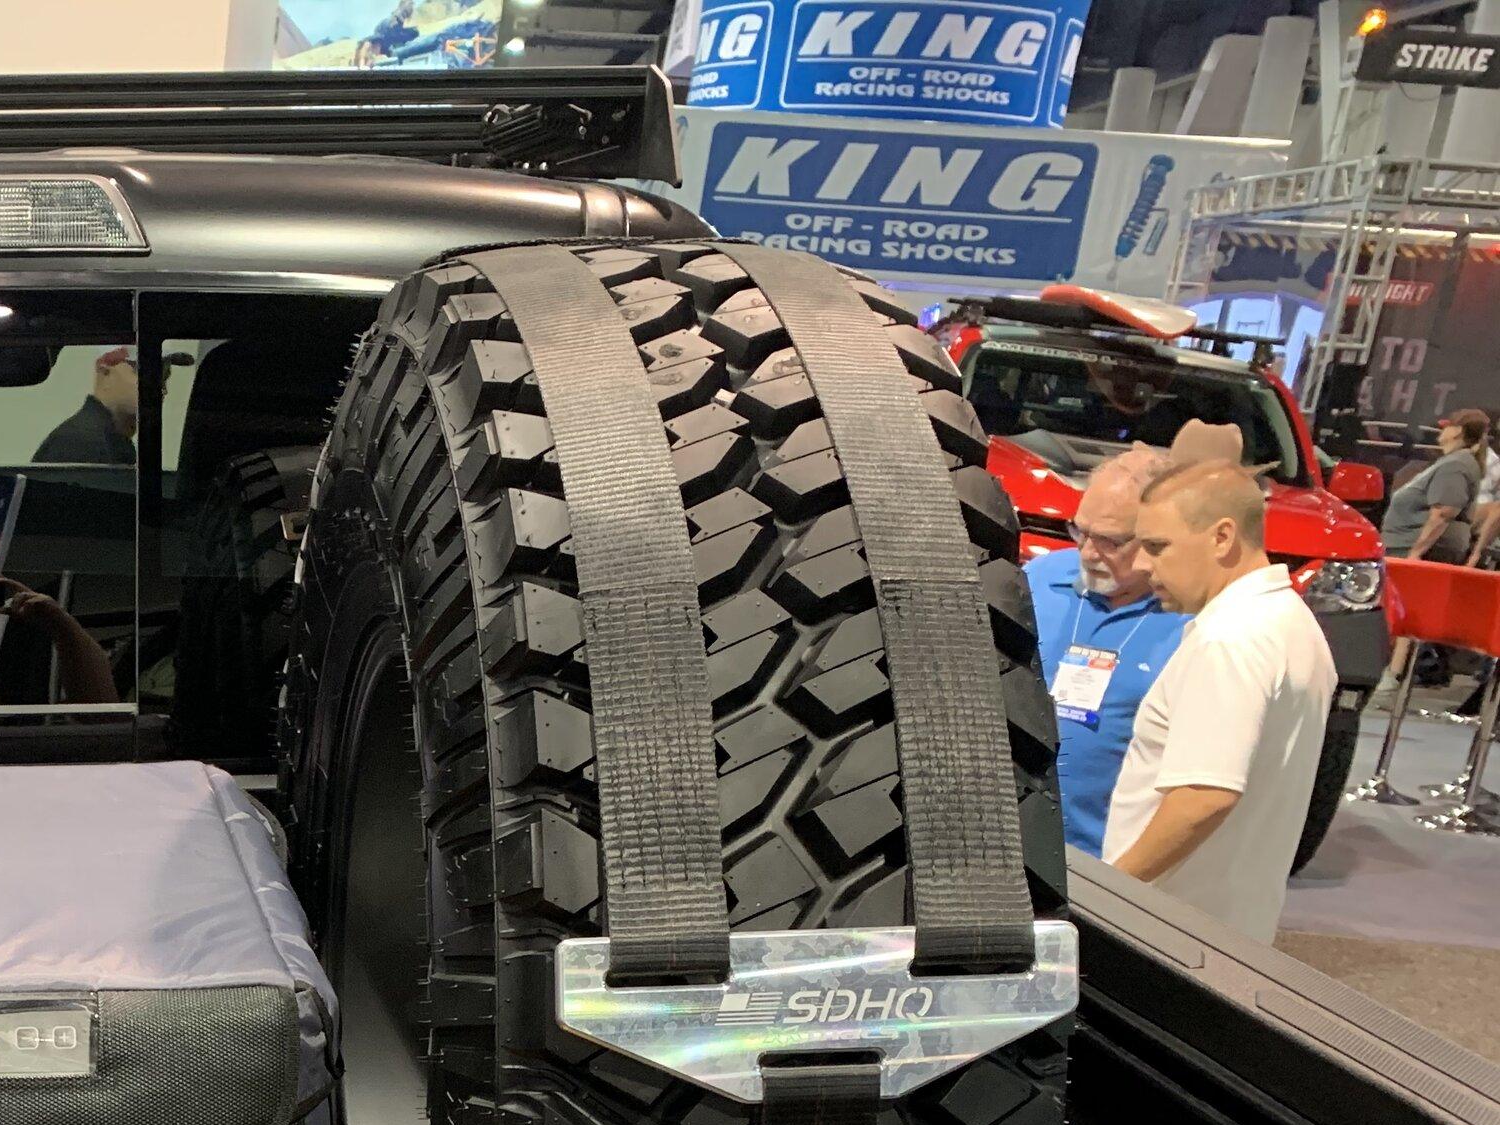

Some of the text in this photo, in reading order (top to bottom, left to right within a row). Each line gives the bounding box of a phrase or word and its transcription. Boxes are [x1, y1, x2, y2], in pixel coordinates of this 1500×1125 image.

[798, 10, 1047, 66] KING
[1395, 43, 1495, 73] STRIKE
[849, 66, 902, 81] OFF
[922, 69, 996, 87] ROAD
[814, 82, 1011, 105] RACING SHOCKS
[714, 136, 1084, 213] KING
[784, 213, 854, 234] OFF
[882, 219, 989, 241] ROAD
[880, 241, 1017, 265] SHOCKS
[783, 987, 934, 1024] SDHQ
